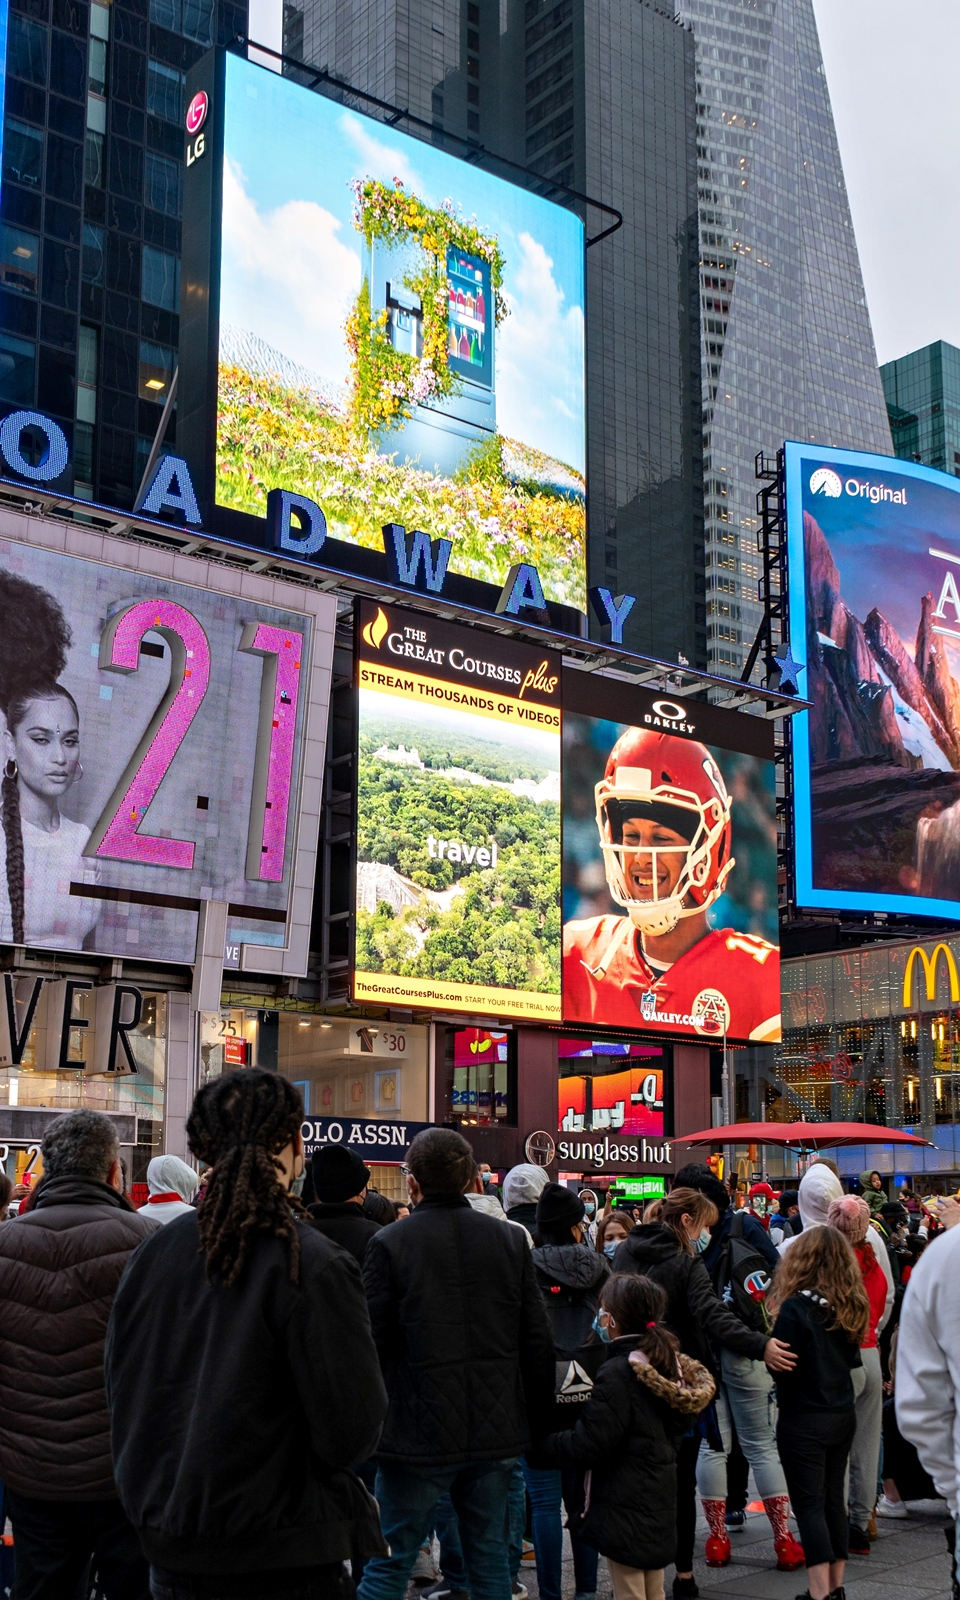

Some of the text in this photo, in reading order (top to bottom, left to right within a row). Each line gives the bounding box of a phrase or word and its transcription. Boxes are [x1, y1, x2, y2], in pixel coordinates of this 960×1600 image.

[186, 133, 205, 167] LG
[845, 478, 908, 506] Original
[404, 626, 427, 643] THE
[387, 632, 559, 699] GREAT COURSES plus
[361, 669, 560, 727] STREAM THOUSANDS OF VIDEOS
[644, 714, 696, 734] OAKLEY
[96, 599, 304, 883] 21
[426, 834, 498, 868] travel
[226, 946, 239, 961] VE
[356, 982, 463, 1002] TheGreatCoursesPlus.com
[464, 995, 486, 1005] START
[487, 998, 506, 1007] YOUR
[507, 1000, 524, 1009] FREE
[525, 1002, 544, 1011] TRIAL
[3, 972, 143, 1074] VER
[642, 1010, 705, 1027] OAKLEY.COM
[382, 1032, 406, 1052] $30
[301, 1121, 411, 1146] OLO ASSN.
[559, 1136, 672, 1168] sunglass hut
[556, 1391, 592, 1404] Reebo
